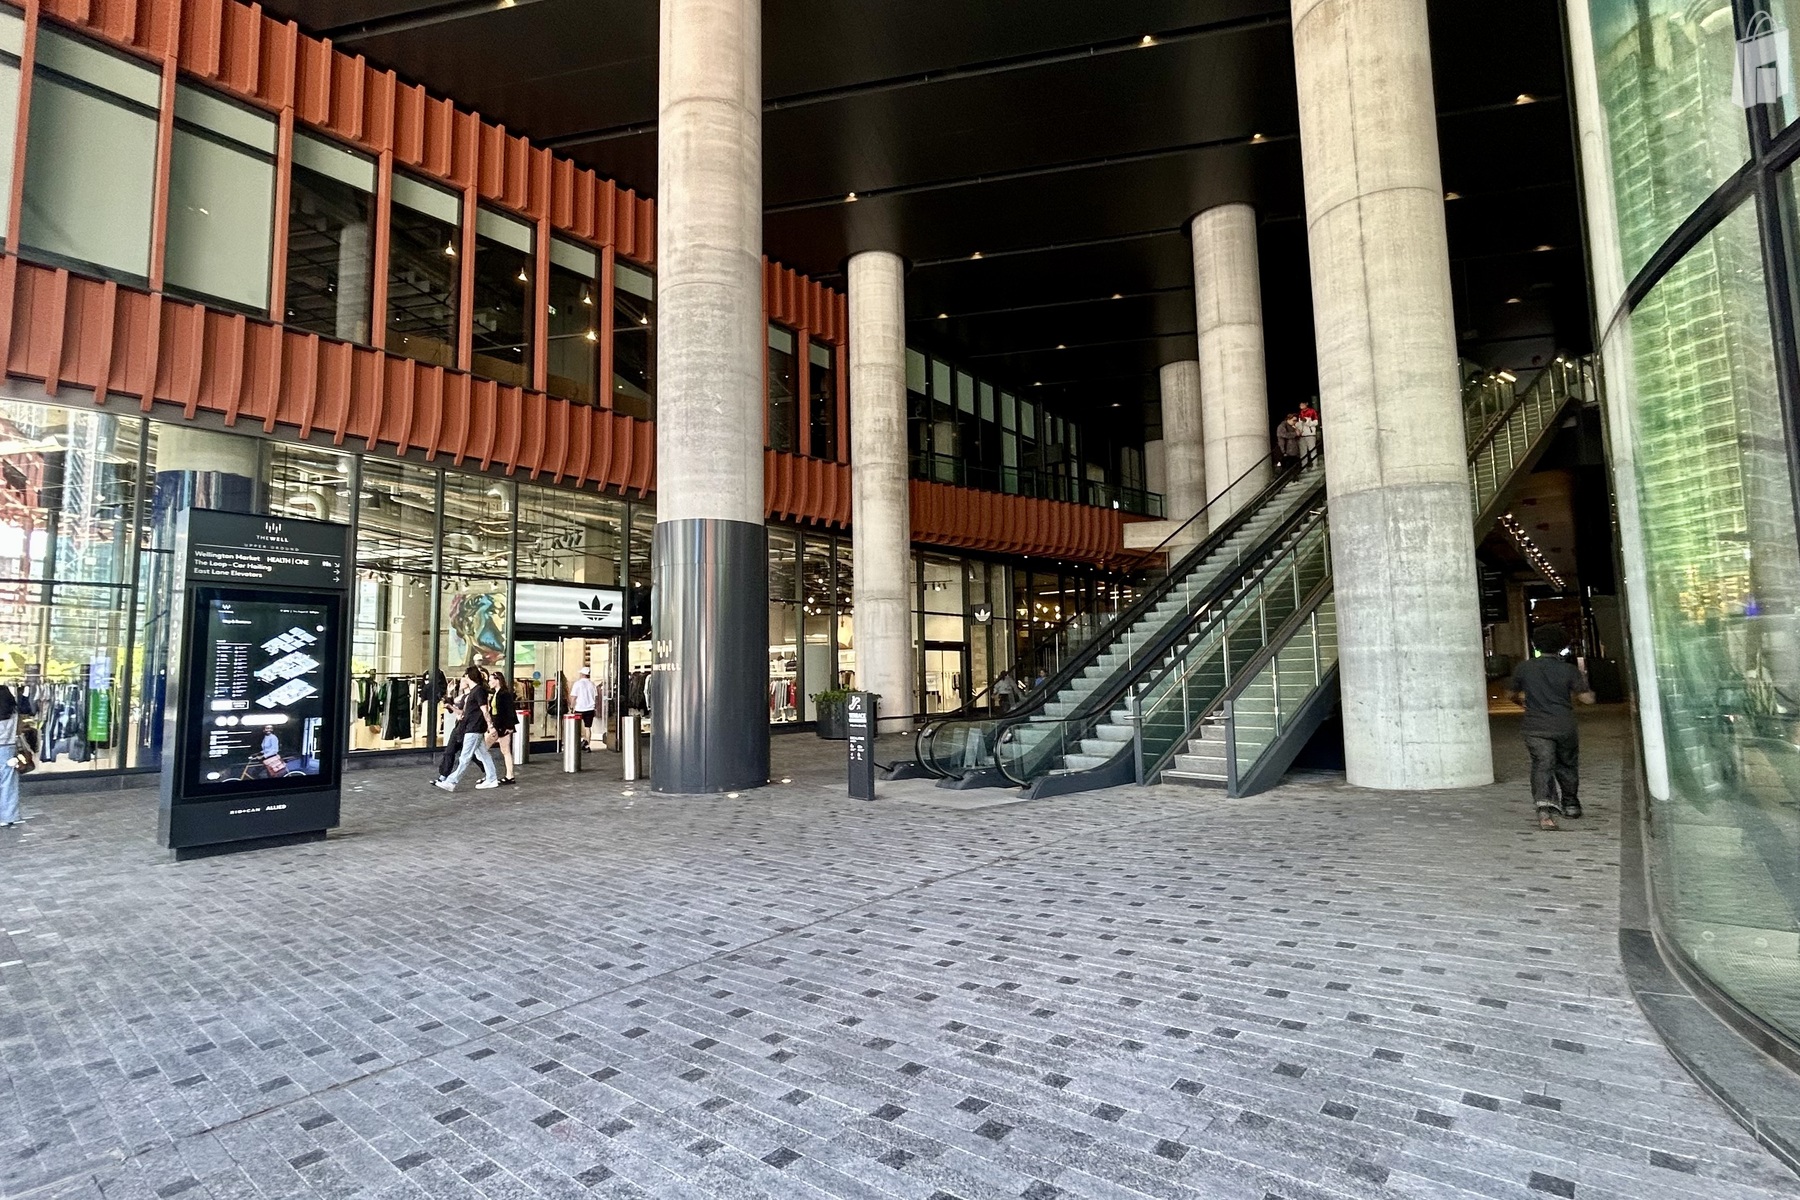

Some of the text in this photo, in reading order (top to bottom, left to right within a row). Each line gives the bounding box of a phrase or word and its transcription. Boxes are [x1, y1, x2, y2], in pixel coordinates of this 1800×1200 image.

[194, 550, 261, 562] Wellington Market
[266, 556, 310, 566] HEALTH ONE
[194, 558, 208, 566] The
[209, 560, 228, 568] Loop
[247, 563, 273, 572] Hailing
[211, 568, 230, 576] Lane
[231, 570, 263, 578] Elevators
